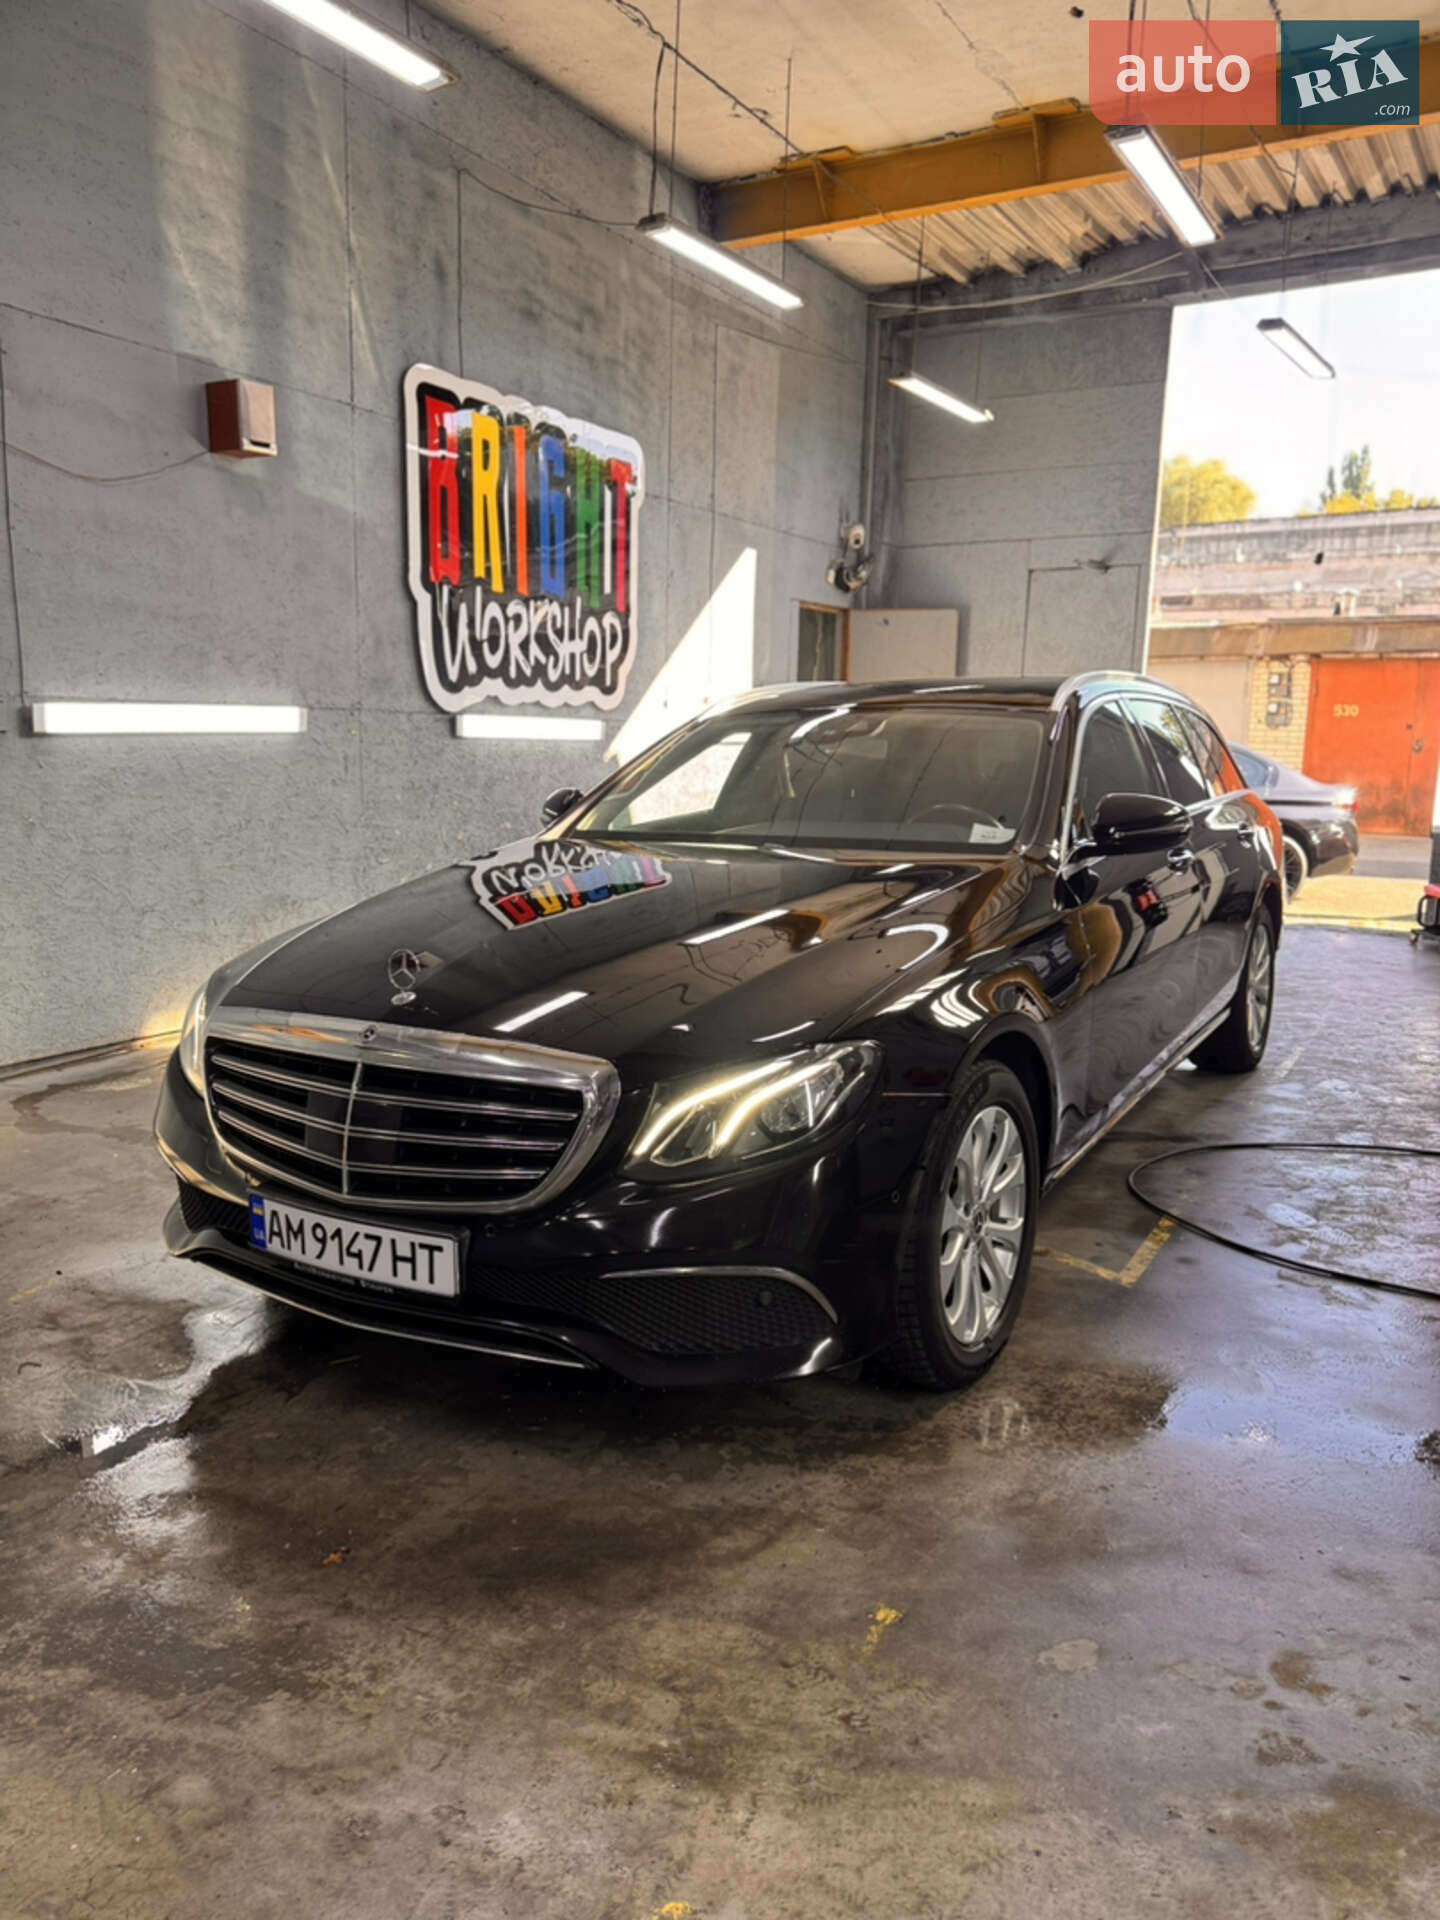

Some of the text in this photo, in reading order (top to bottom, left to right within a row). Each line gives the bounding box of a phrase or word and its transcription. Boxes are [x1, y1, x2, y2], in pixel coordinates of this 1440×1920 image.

[425, 395, 633, 615] BRIGHT
[442, 584, 623, 687] WORKSHOP
[1333, 703, 1360, 718] 530
[267, 1209, 306, 1255] AM
[311, 1222, 383, 1273] 9147
[390, 1238, 444, 1285] HT
